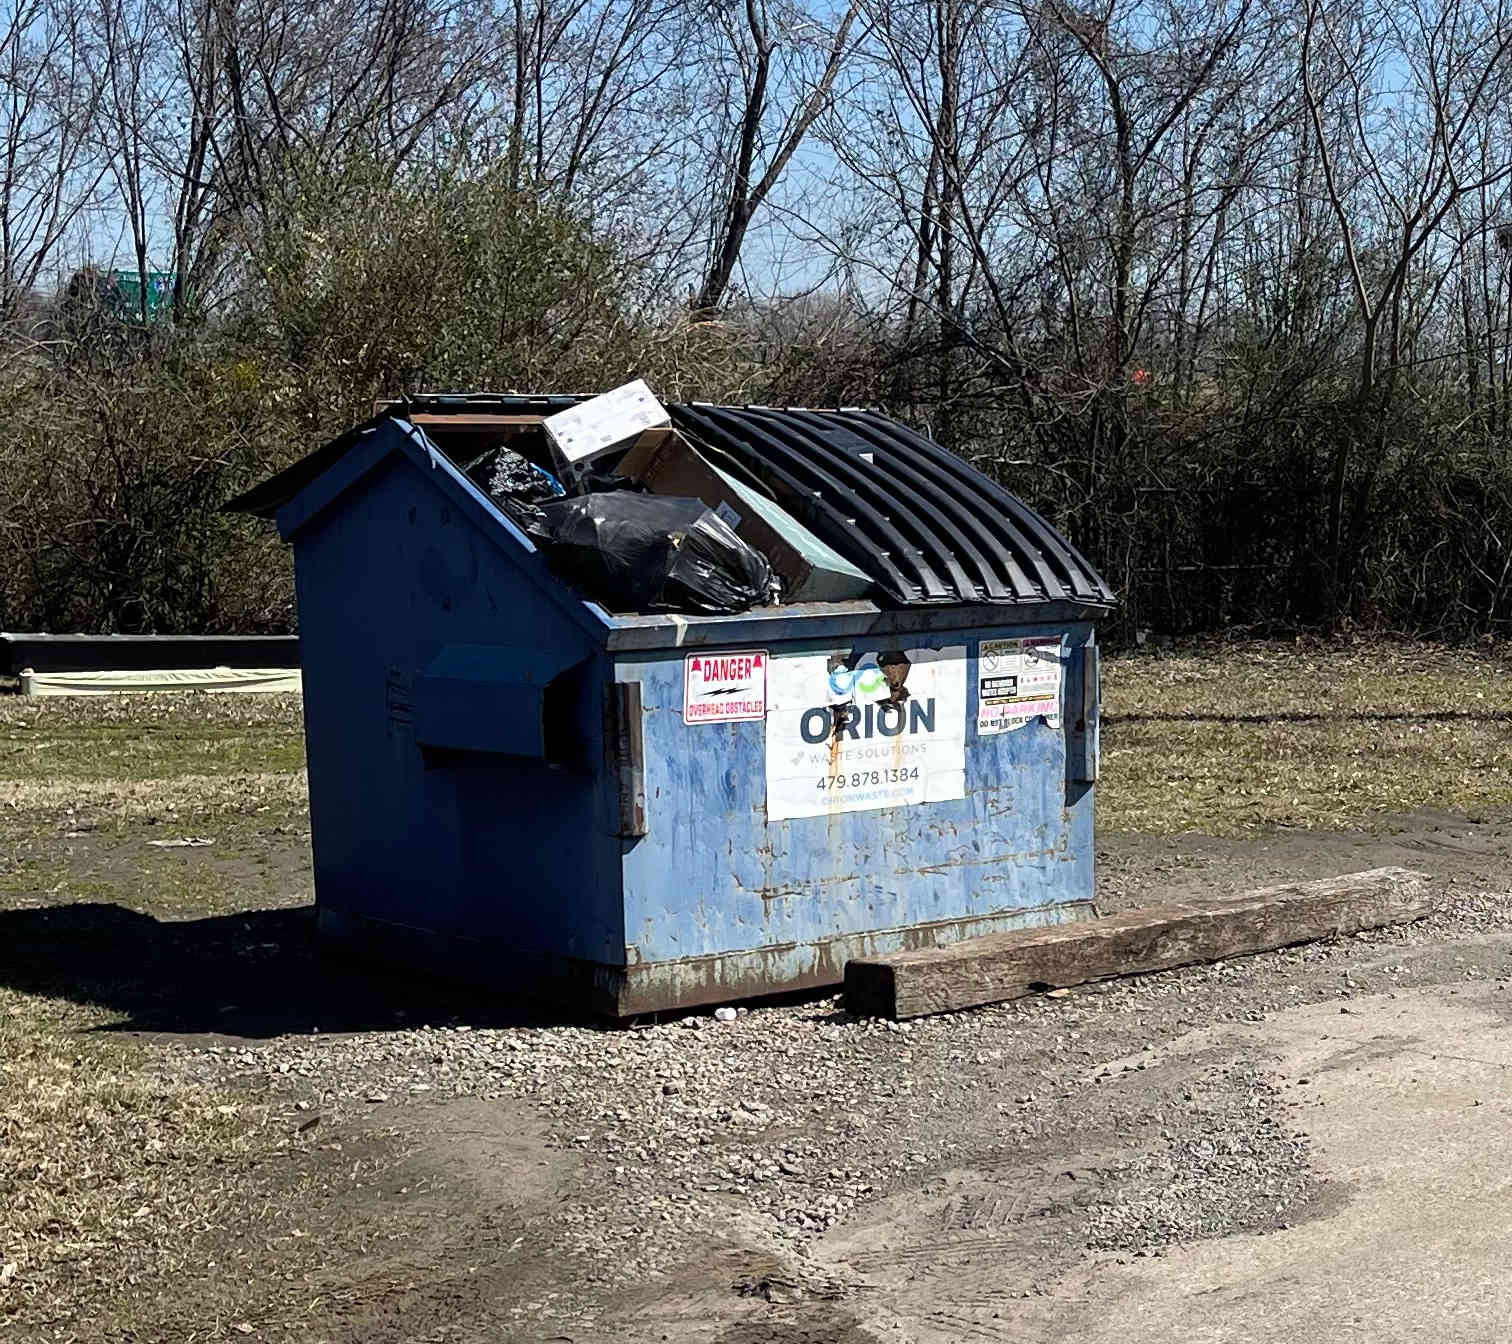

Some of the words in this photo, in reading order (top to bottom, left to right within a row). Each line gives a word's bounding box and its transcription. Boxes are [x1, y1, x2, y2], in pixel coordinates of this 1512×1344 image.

[703, 657, 752, 682] DANGER
[689, 702, 724, 717] OVERHEAD
[725, 700, 763, 714] OBSTACLES
[800, 697, 936, 745] ORION
[809, 751, 851, 765] WASTE
[857, 743, 927, 760] SOLUTIONS
[816, 767, 920, 791] 479.878.1384
